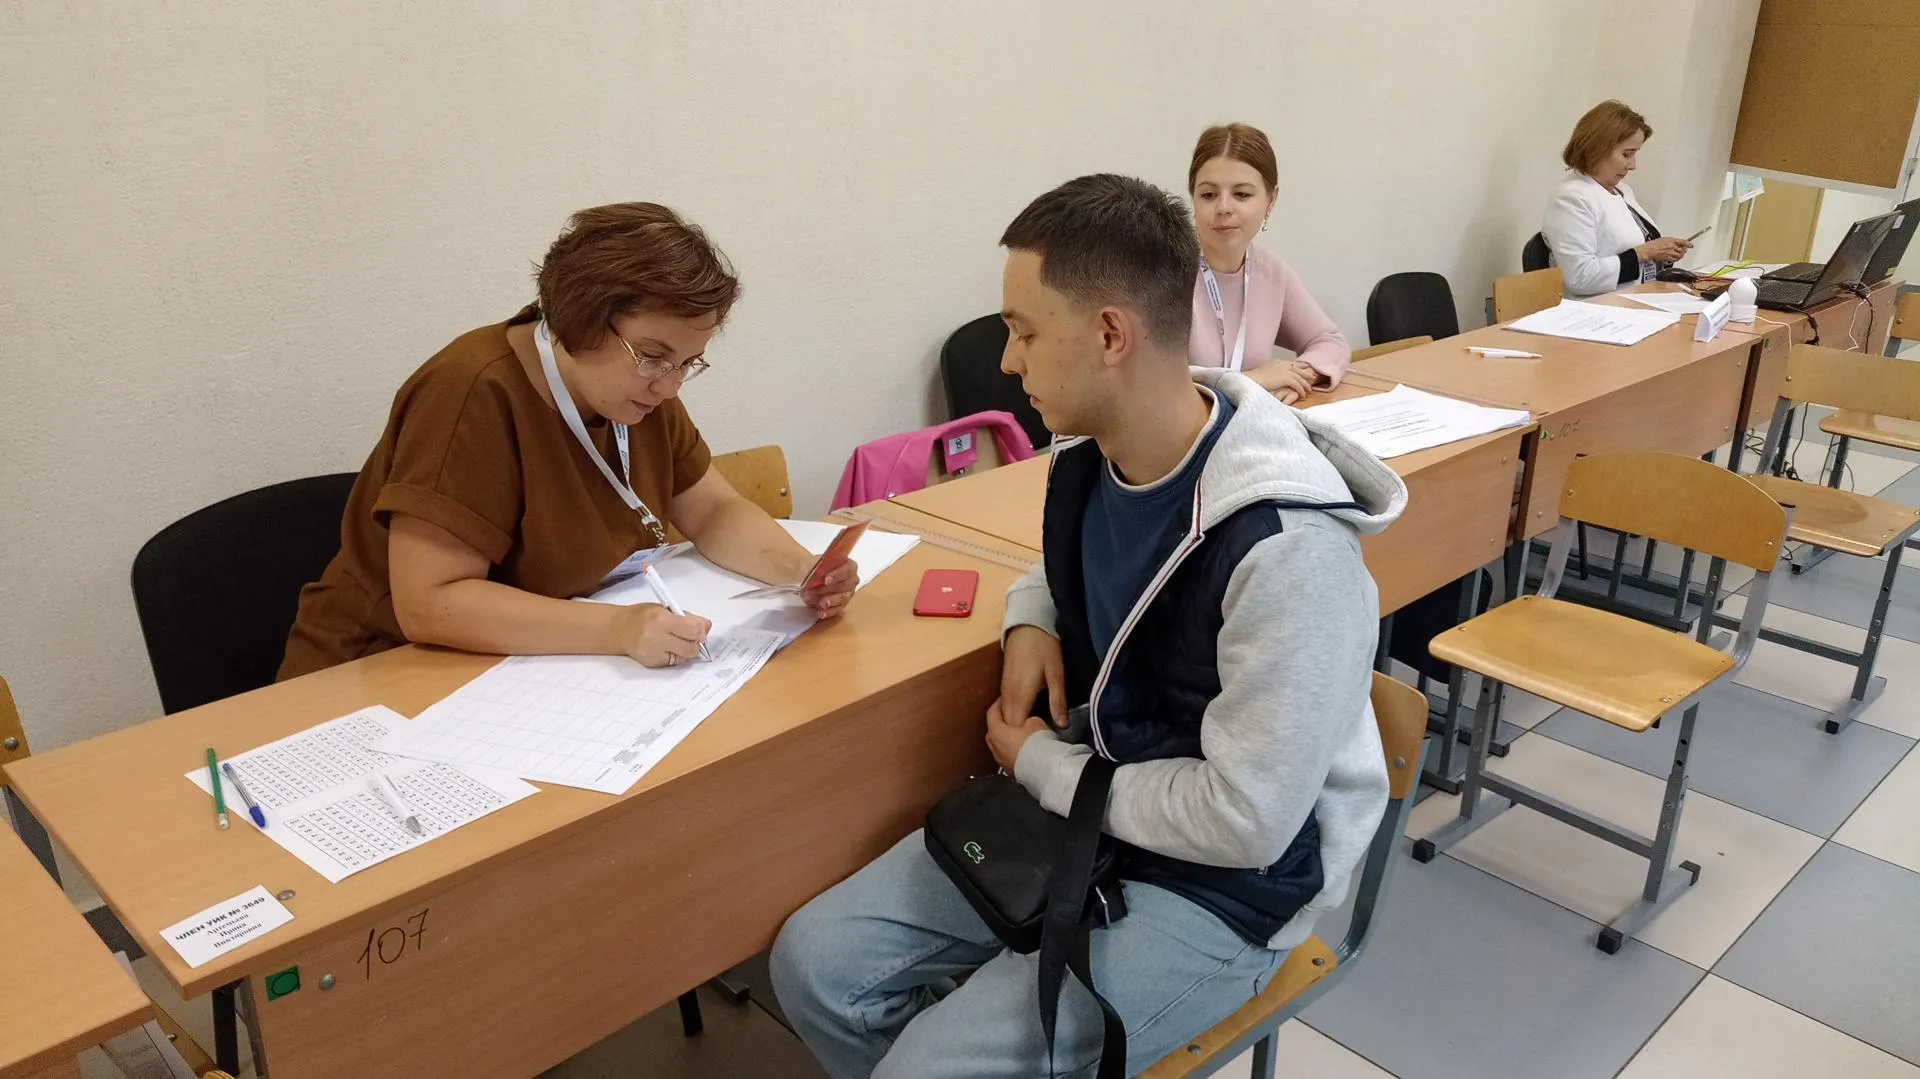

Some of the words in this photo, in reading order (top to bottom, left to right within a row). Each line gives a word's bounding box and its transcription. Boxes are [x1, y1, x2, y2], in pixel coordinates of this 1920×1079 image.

[175, 924, 206, 941] ЧЛЕН
[206, 913, 228, 926] УИК
[219, 922, 247, 938] Ирина
[356, 907, 430, 981] 107
